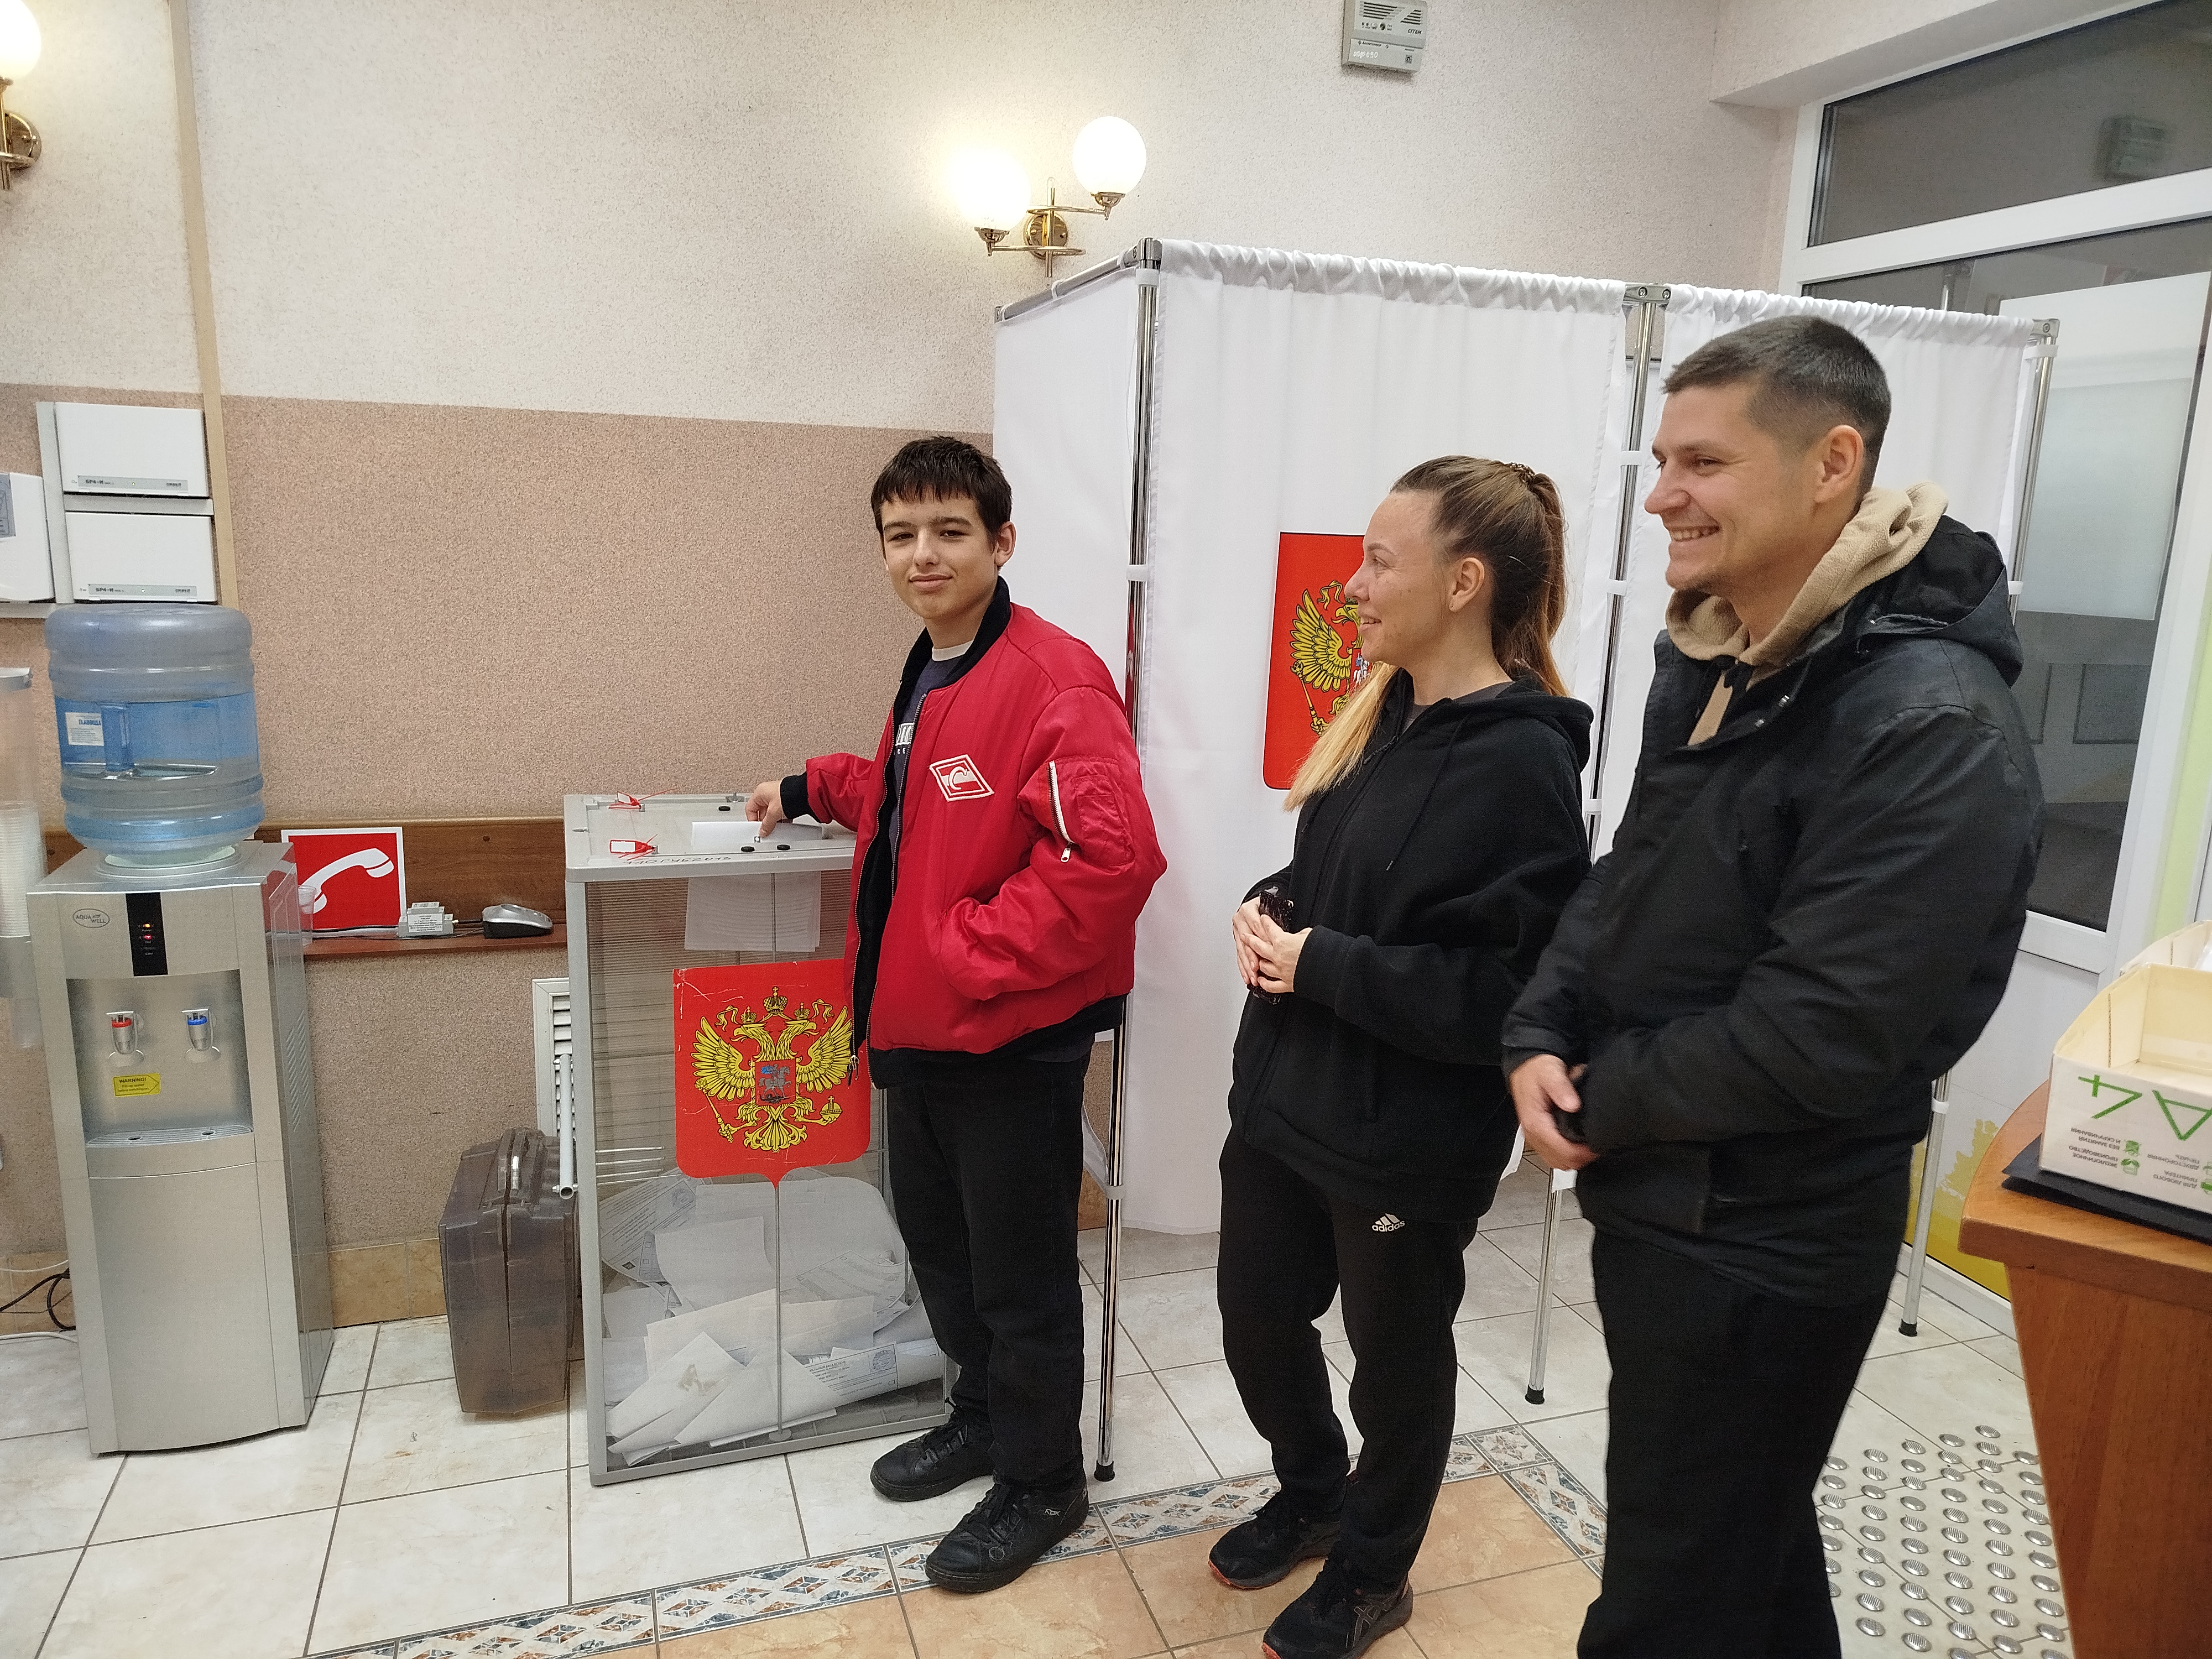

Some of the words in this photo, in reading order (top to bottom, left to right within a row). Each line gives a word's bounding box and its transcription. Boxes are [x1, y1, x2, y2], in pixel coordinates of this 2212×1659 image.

[2078, 1074, 2212, 1141] A4
[2070, 1128, 2115, 1142] СКРУЧИВАНИЯ
[2069, 1145, 2118, 1162] ПРОИЗВОДСТВО
[2072, 1152, 2118, 1168] ЭКОЛОГИЧНОЕ
[2175, 1154, 2199, 1164] ПЕЧАТЬ
[2147, 1154, 2199, 1170] ДВУСТОРОННЯЯ
[2153, 1174, 2182, 1185] ЛЮБОГО
[2164, 1170, 2198, 1183] ПРИНТЕРА
[1372, 1220, 1405, 1232] adidas
